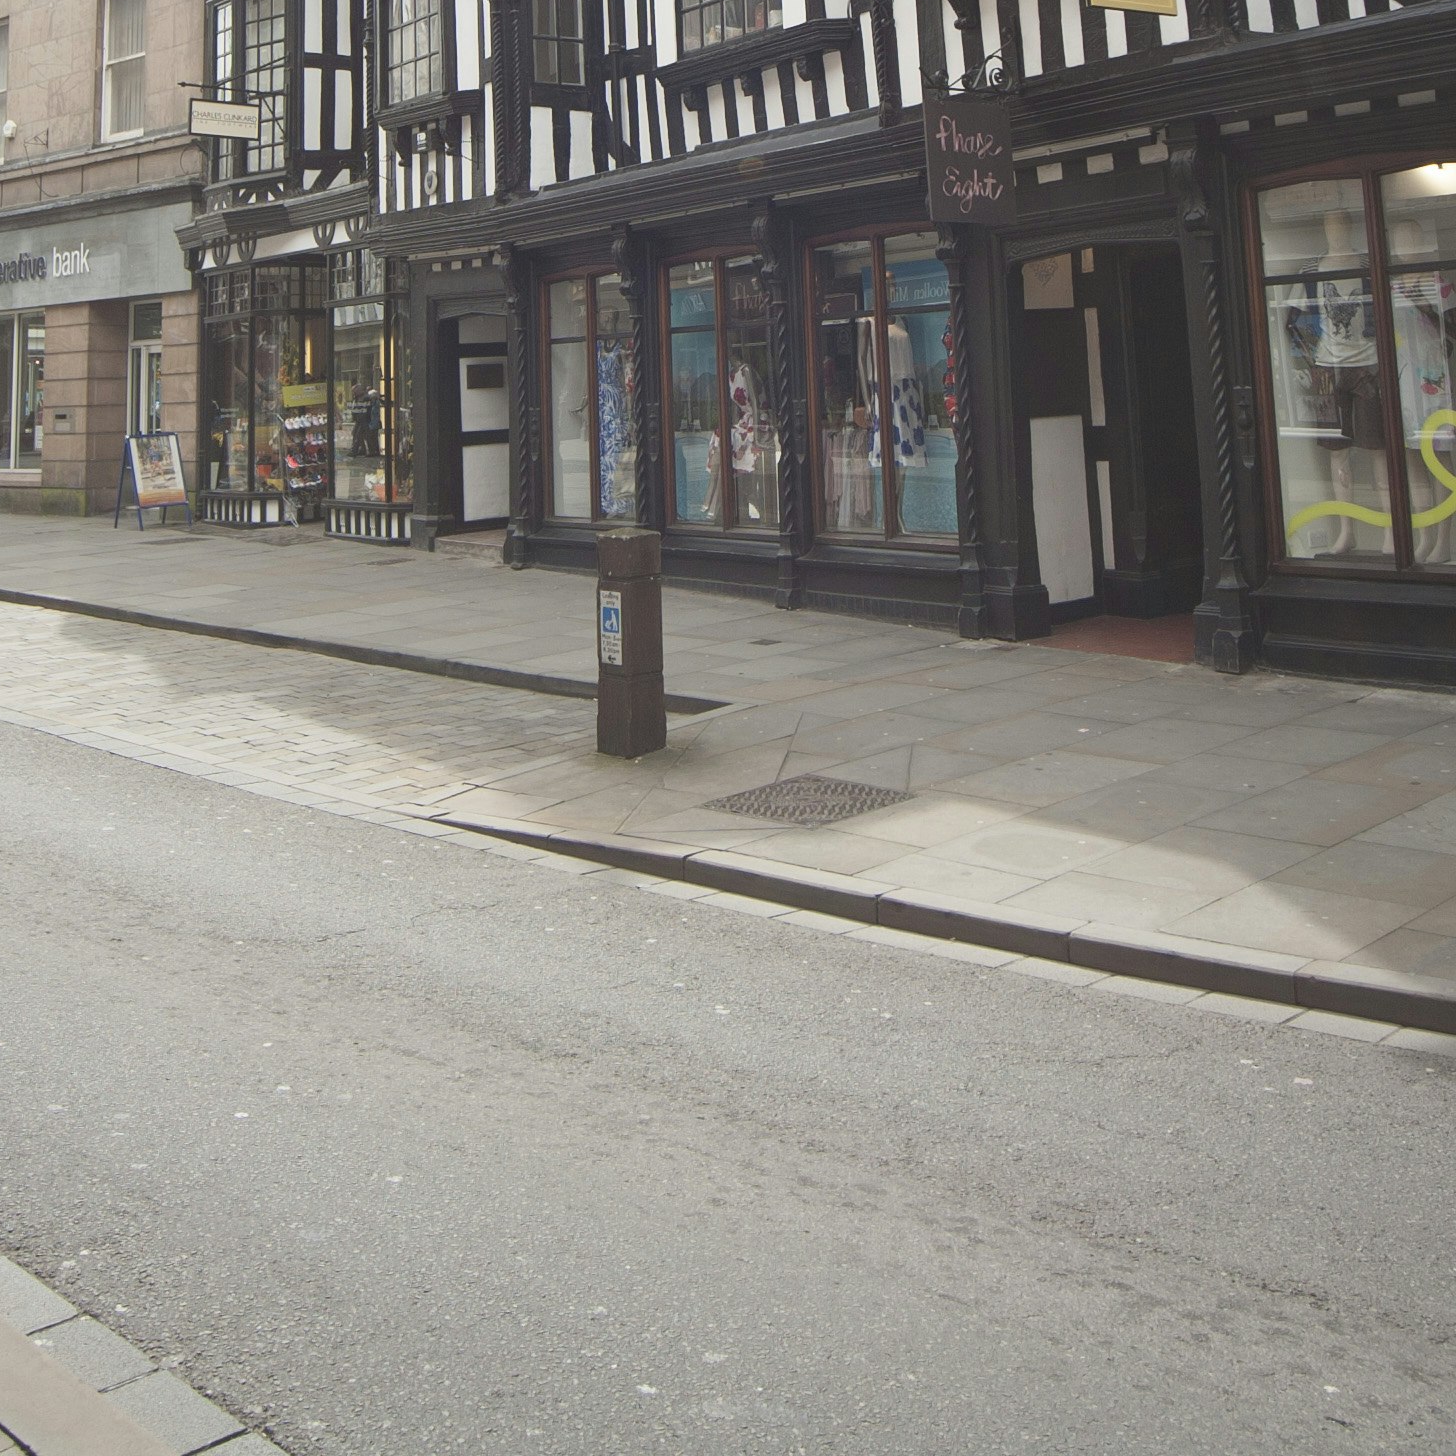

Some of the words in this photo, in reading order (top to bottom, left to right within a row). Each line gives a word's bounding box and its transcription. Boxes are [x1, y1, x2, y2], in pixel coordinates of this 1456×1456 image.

[192, 110, 221, 120] CHARLES
[224, 113, 258, 124] CLINKARD
[936, 115, 1003, 160] Phase
[942, 165, 1004, 214] Eight
[52, 242, 90, 278] bank
